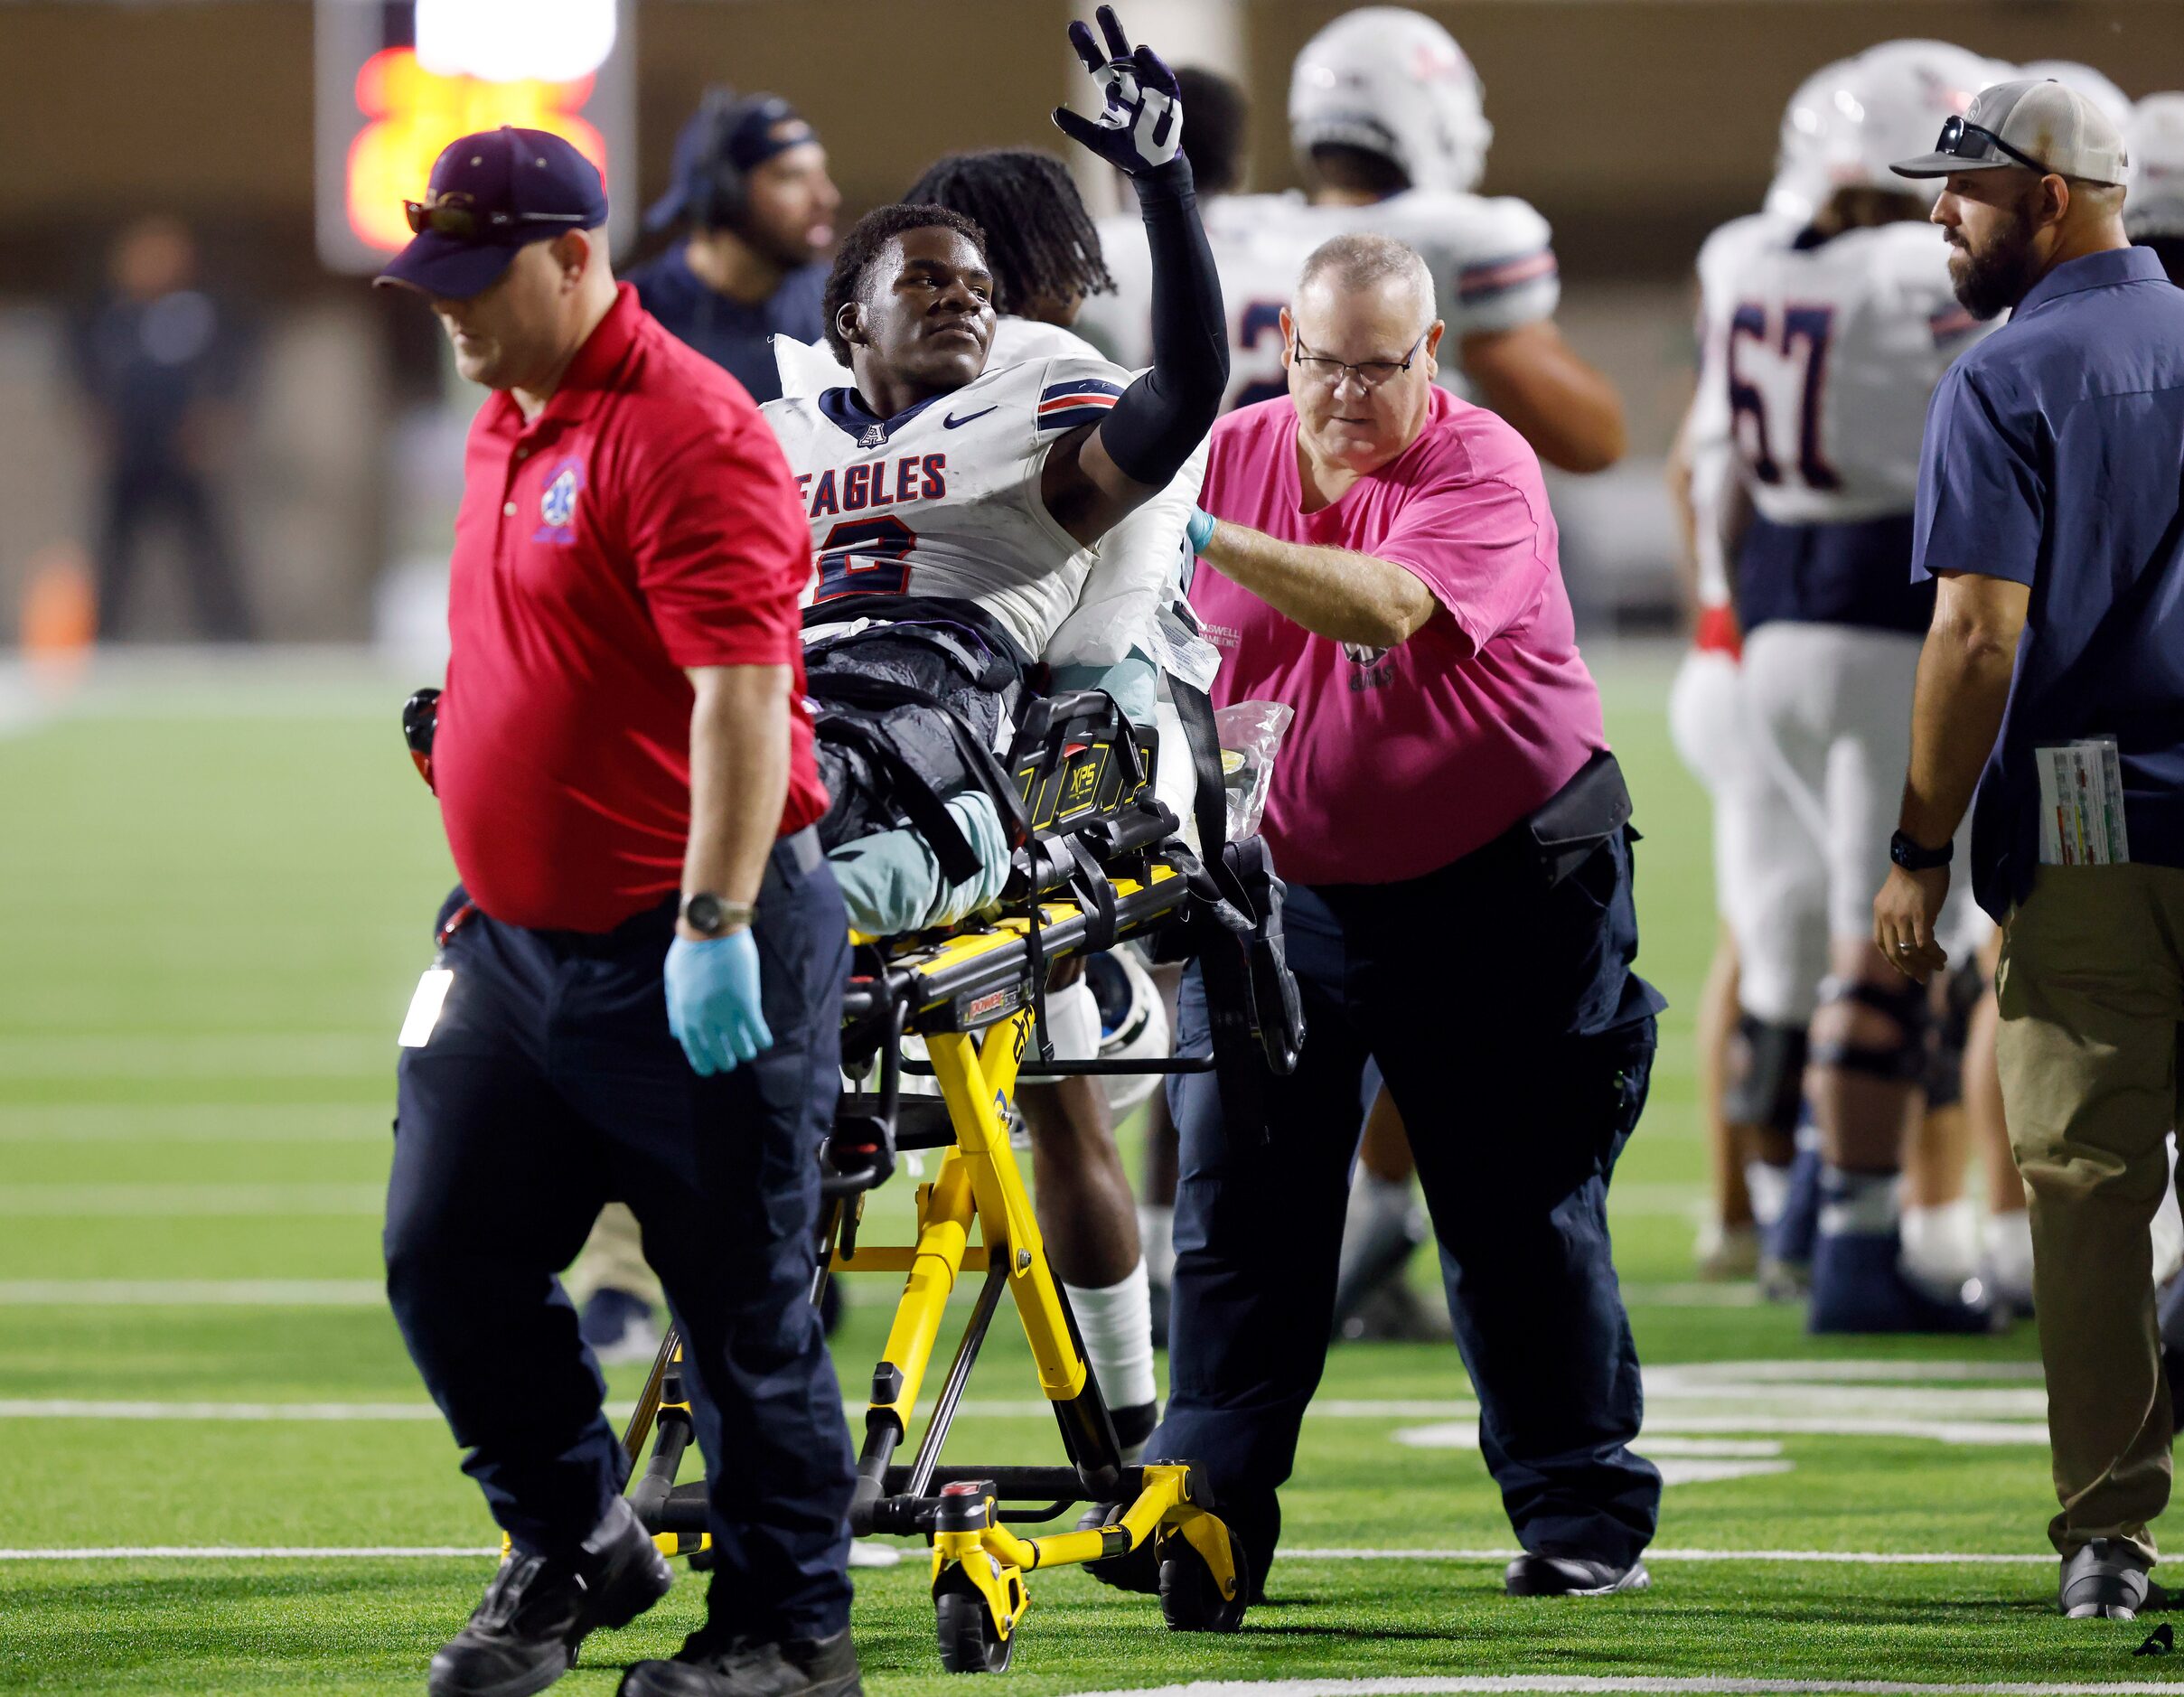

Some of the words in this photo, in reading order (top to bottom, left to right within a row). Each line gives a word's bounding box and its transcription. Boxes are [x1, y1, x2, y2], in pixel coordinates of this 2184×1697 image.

[1728, 303, 1842, 491] 67
[859, 423, 886, 445] A
[812, 514, 918, 605] 2
[1070, 763, 1096, 792] XPS
